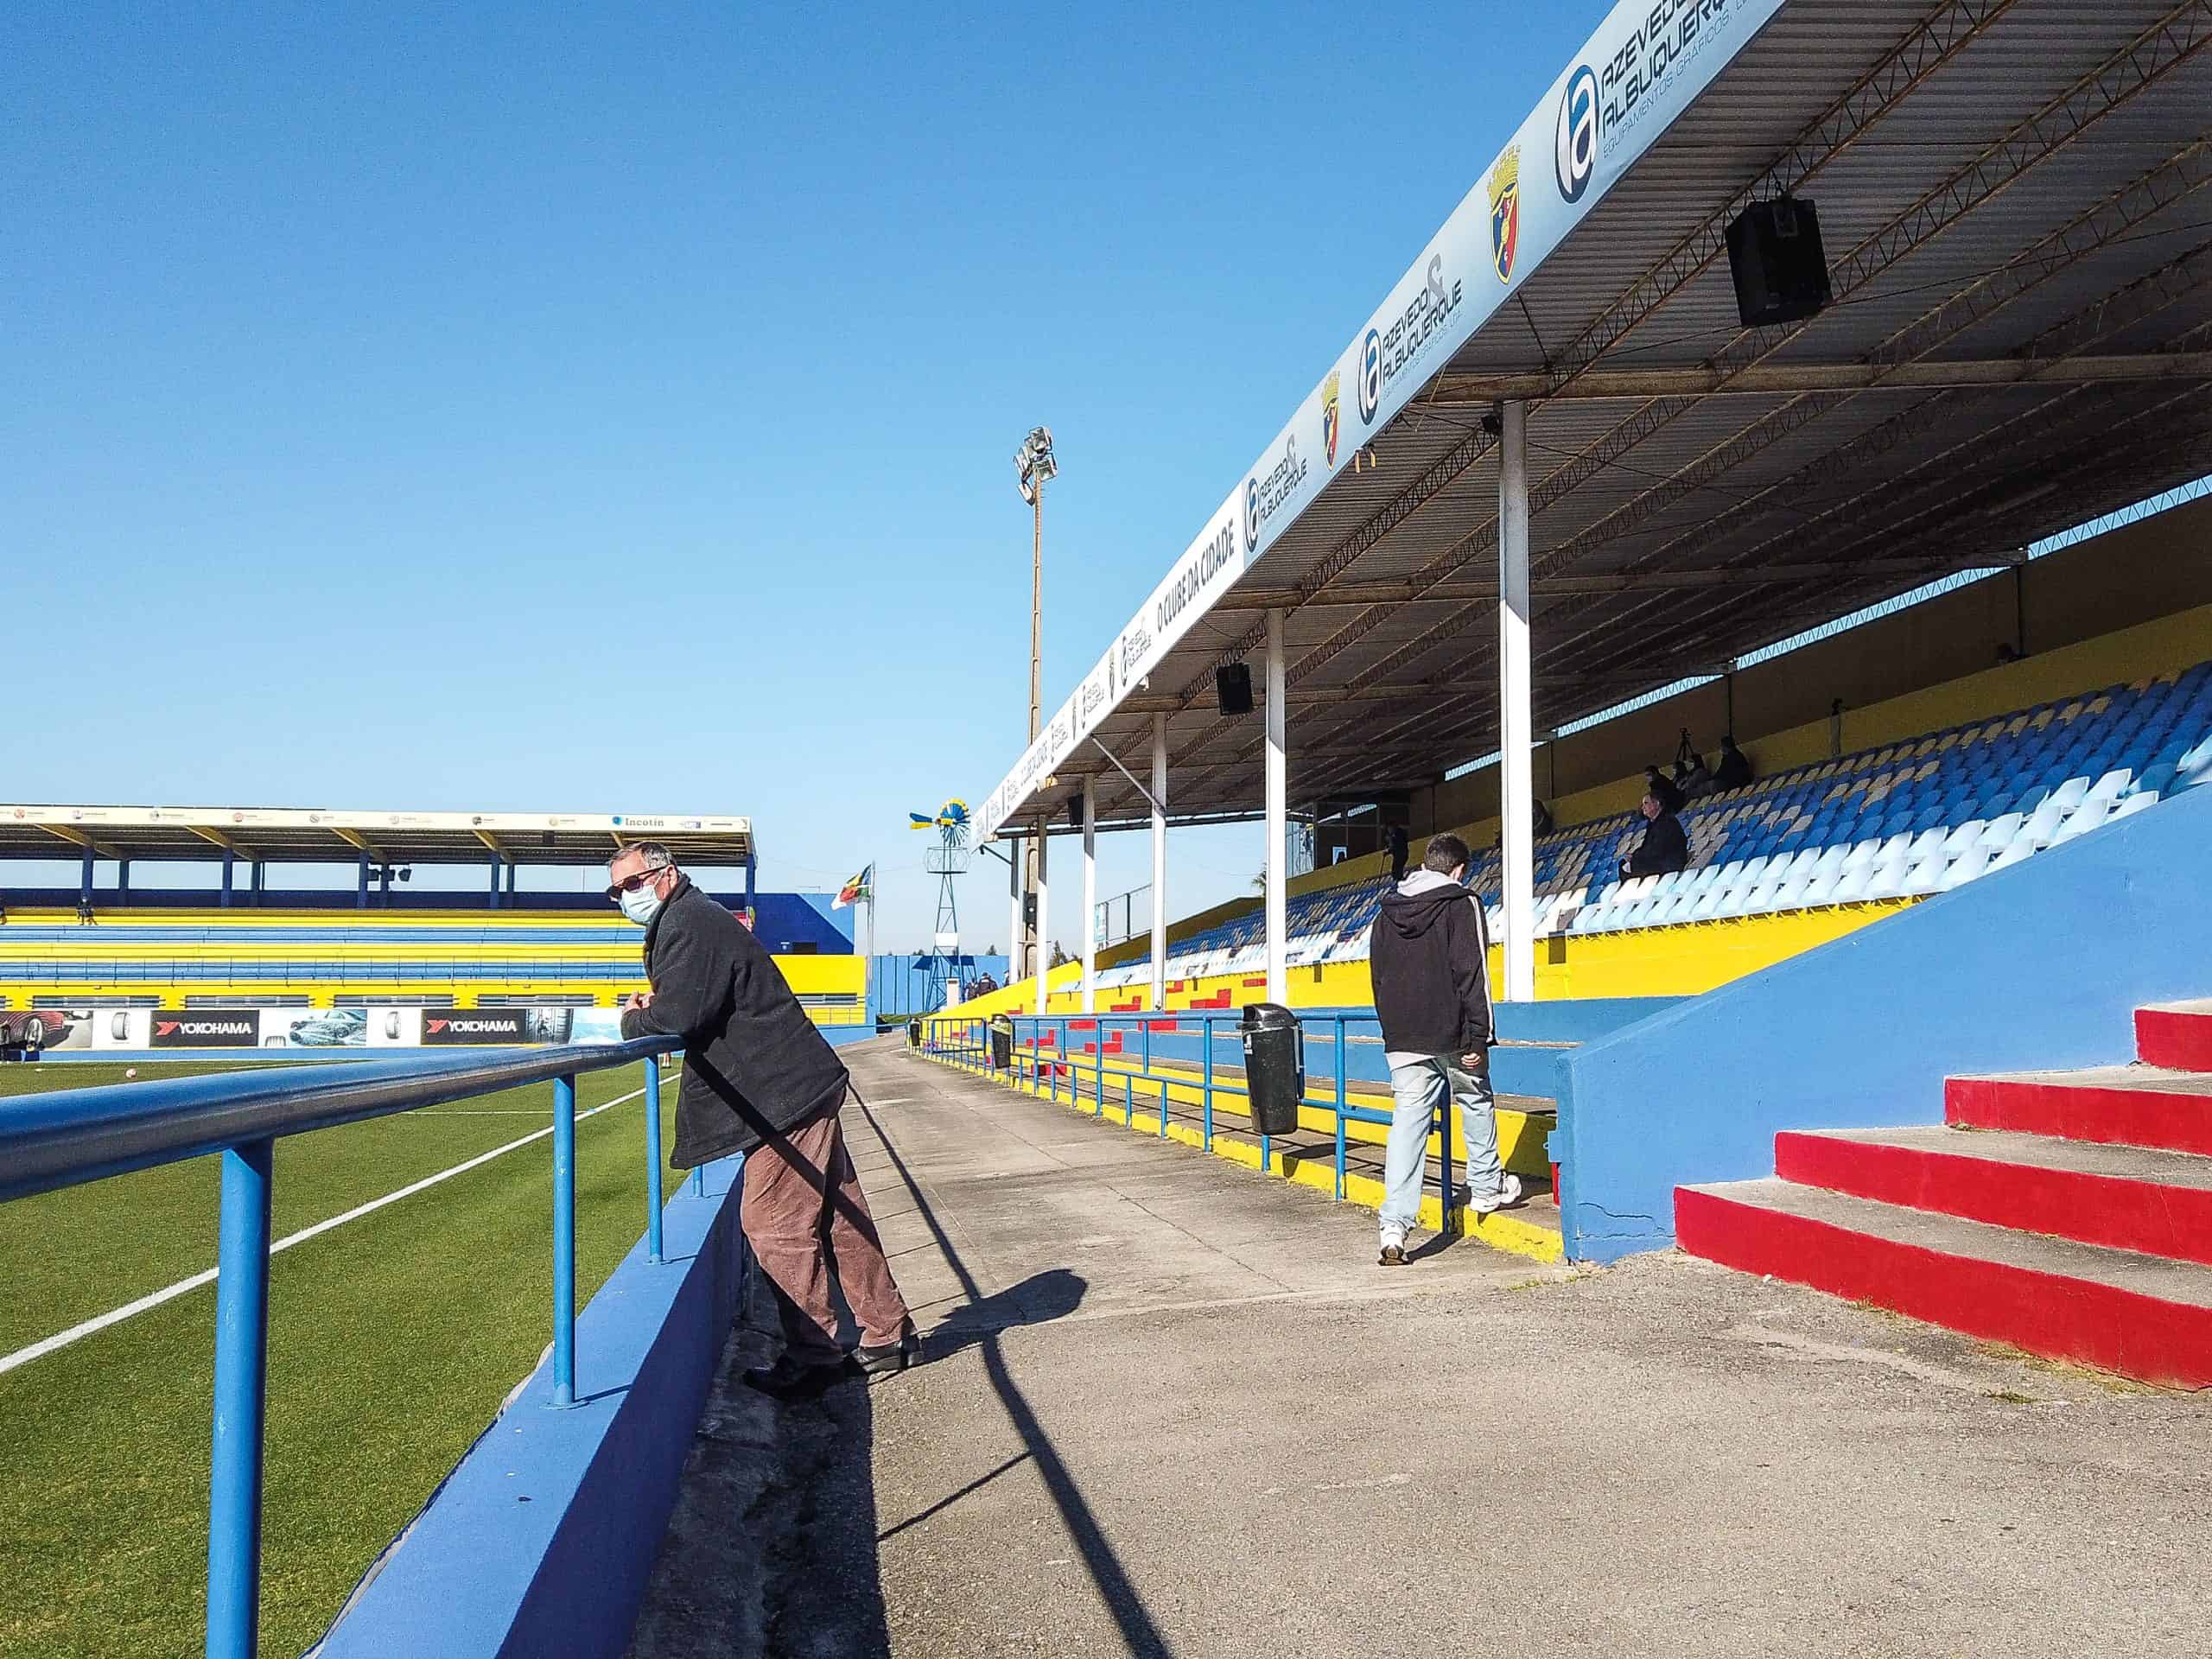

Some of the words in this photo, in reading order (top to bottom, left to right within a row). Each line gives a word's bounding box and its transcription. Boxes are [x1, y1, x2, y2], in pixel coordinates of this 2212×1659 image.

[1382, 287, 1428, 358] AZEVEDO
[1382, 279, 1463, 385] ALBUQUERQUE
[1158, 602, 1163, 633] O
[1164, 574, 1186, 626] CLUBE
[1188, 560, 1199, 602] DA
[1201, 518, 1234, 587] CIDADE
[179, 1022, 252, 1035] YOKOHAMA
[448, 1020, 518, 1033] YOKOHAMA
